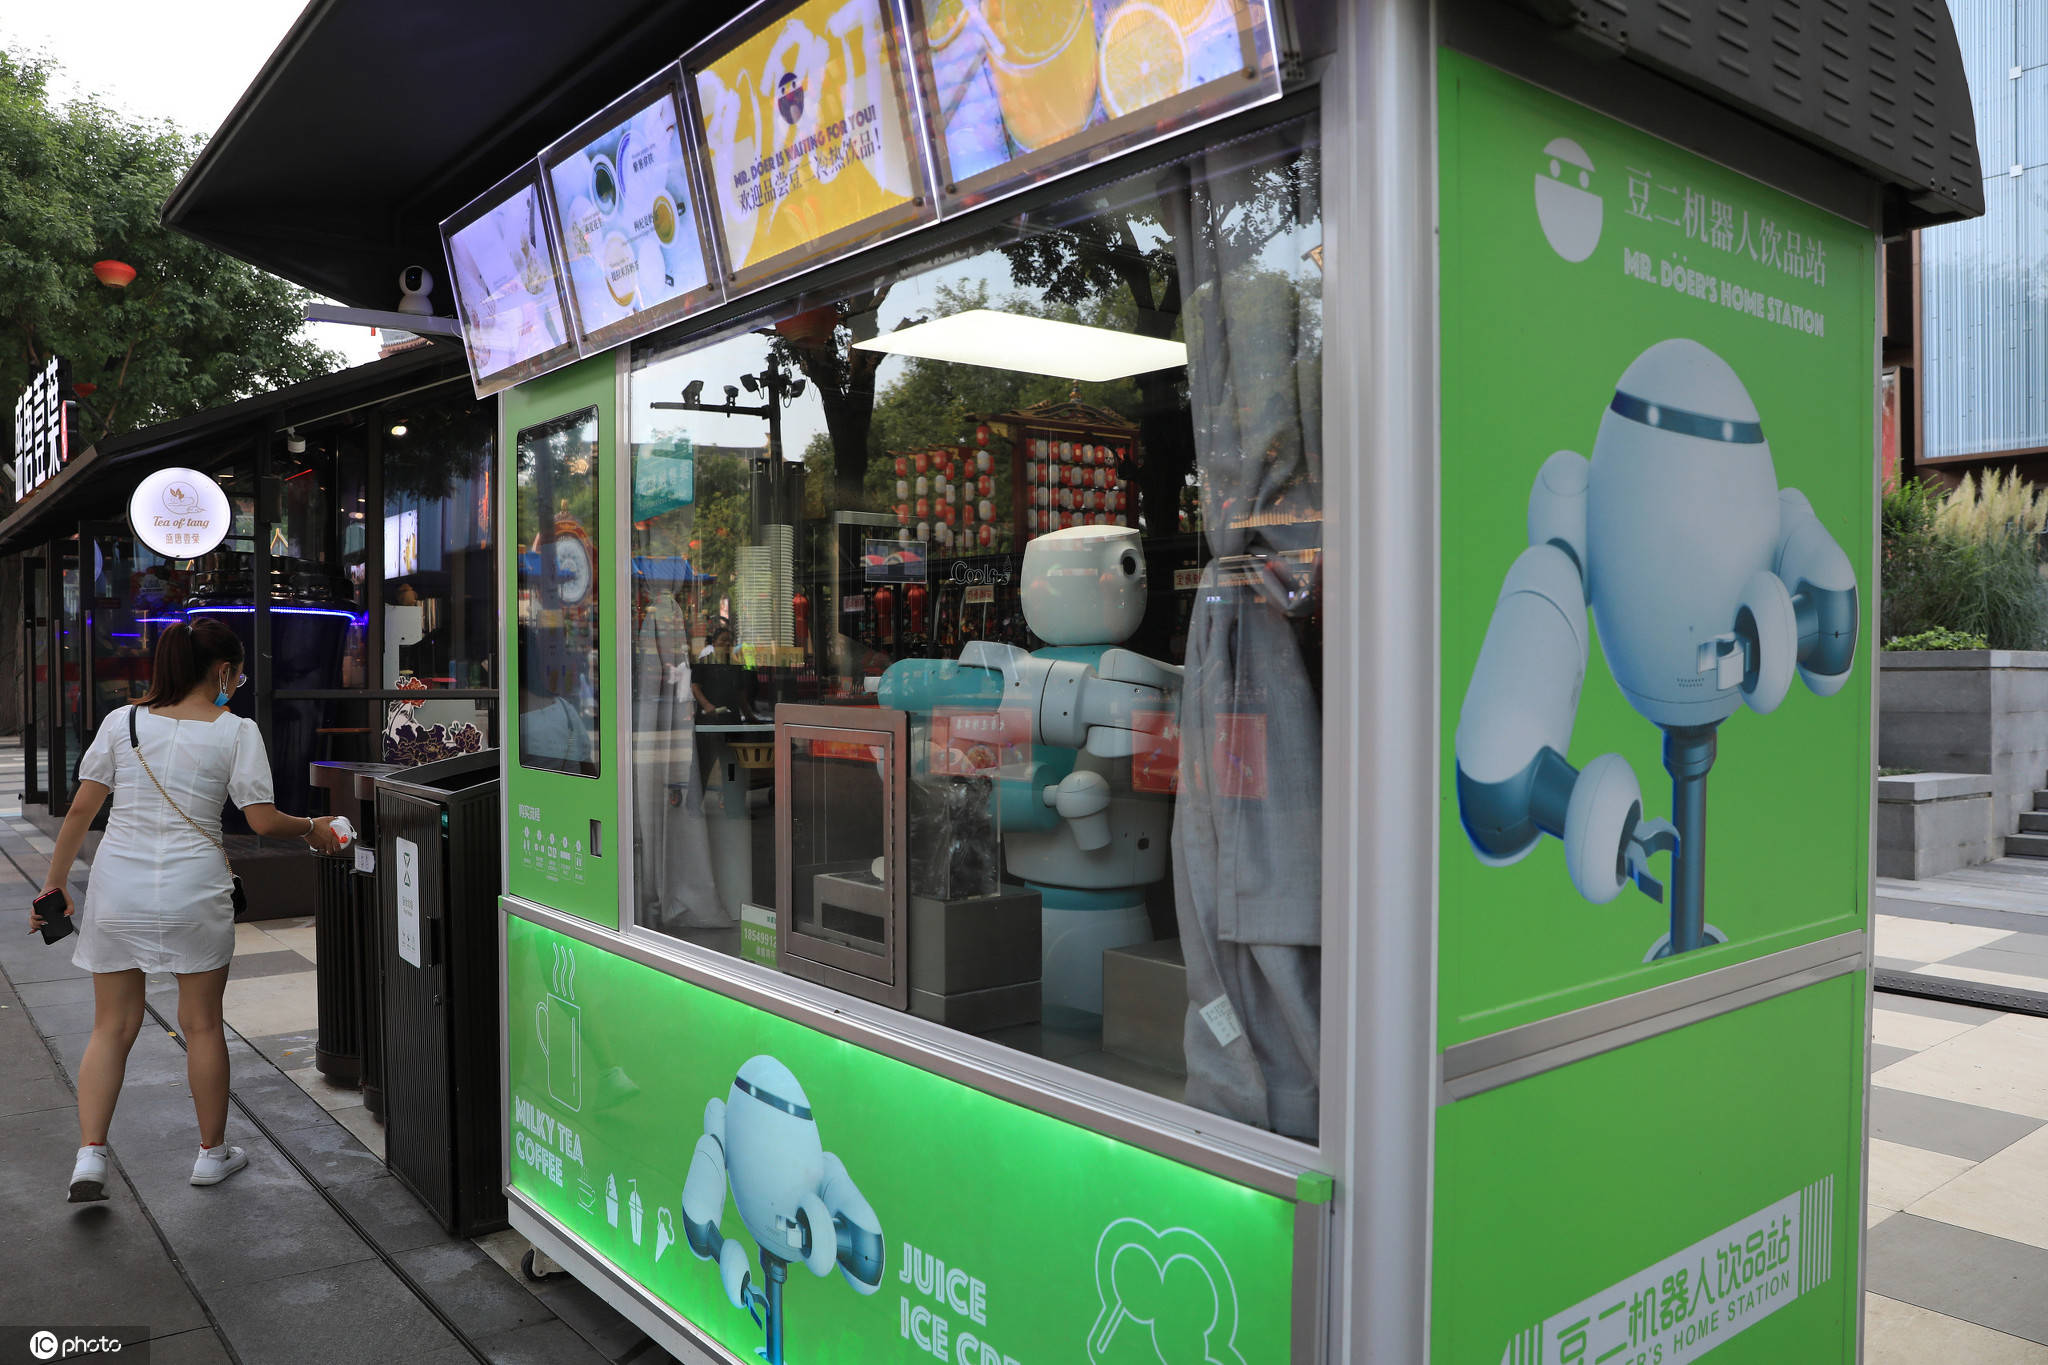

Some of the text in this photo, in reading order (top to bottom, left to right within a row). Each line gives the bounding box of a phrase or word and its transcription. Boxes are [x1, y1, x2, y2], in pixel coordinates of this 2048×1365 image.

[733, 172, 750, 189] MR.
[776, 151, 785, 167] IS
[784, 132, 826, 162] WAITING
[826, 120, 848, 143] FOR
[848, 105, 877, 130] YOU!
[1624, 165, 1827, 287] 豆二机器人饮品站
[1623, 247, 1657, 284] MR.
[1720, 279, 1765, 319] HOME
[1767, 296, 1824, 337] STATION
[153, 516, 210, 529] Tea of tang
[515, 1095, 584, 1168] MILKY TEA
[515, 1131, 563, 1188] COFFEE
[899, 1242, 987, 1327] JUICE
[1556, 1213, 1792, 1365] 豆二机器人饮品站
[1674, 1310, 1720, 1354] HOME
[1727, 1270, 1790, 1323] STATION
[900, 1295, 949, 1364] ICE
